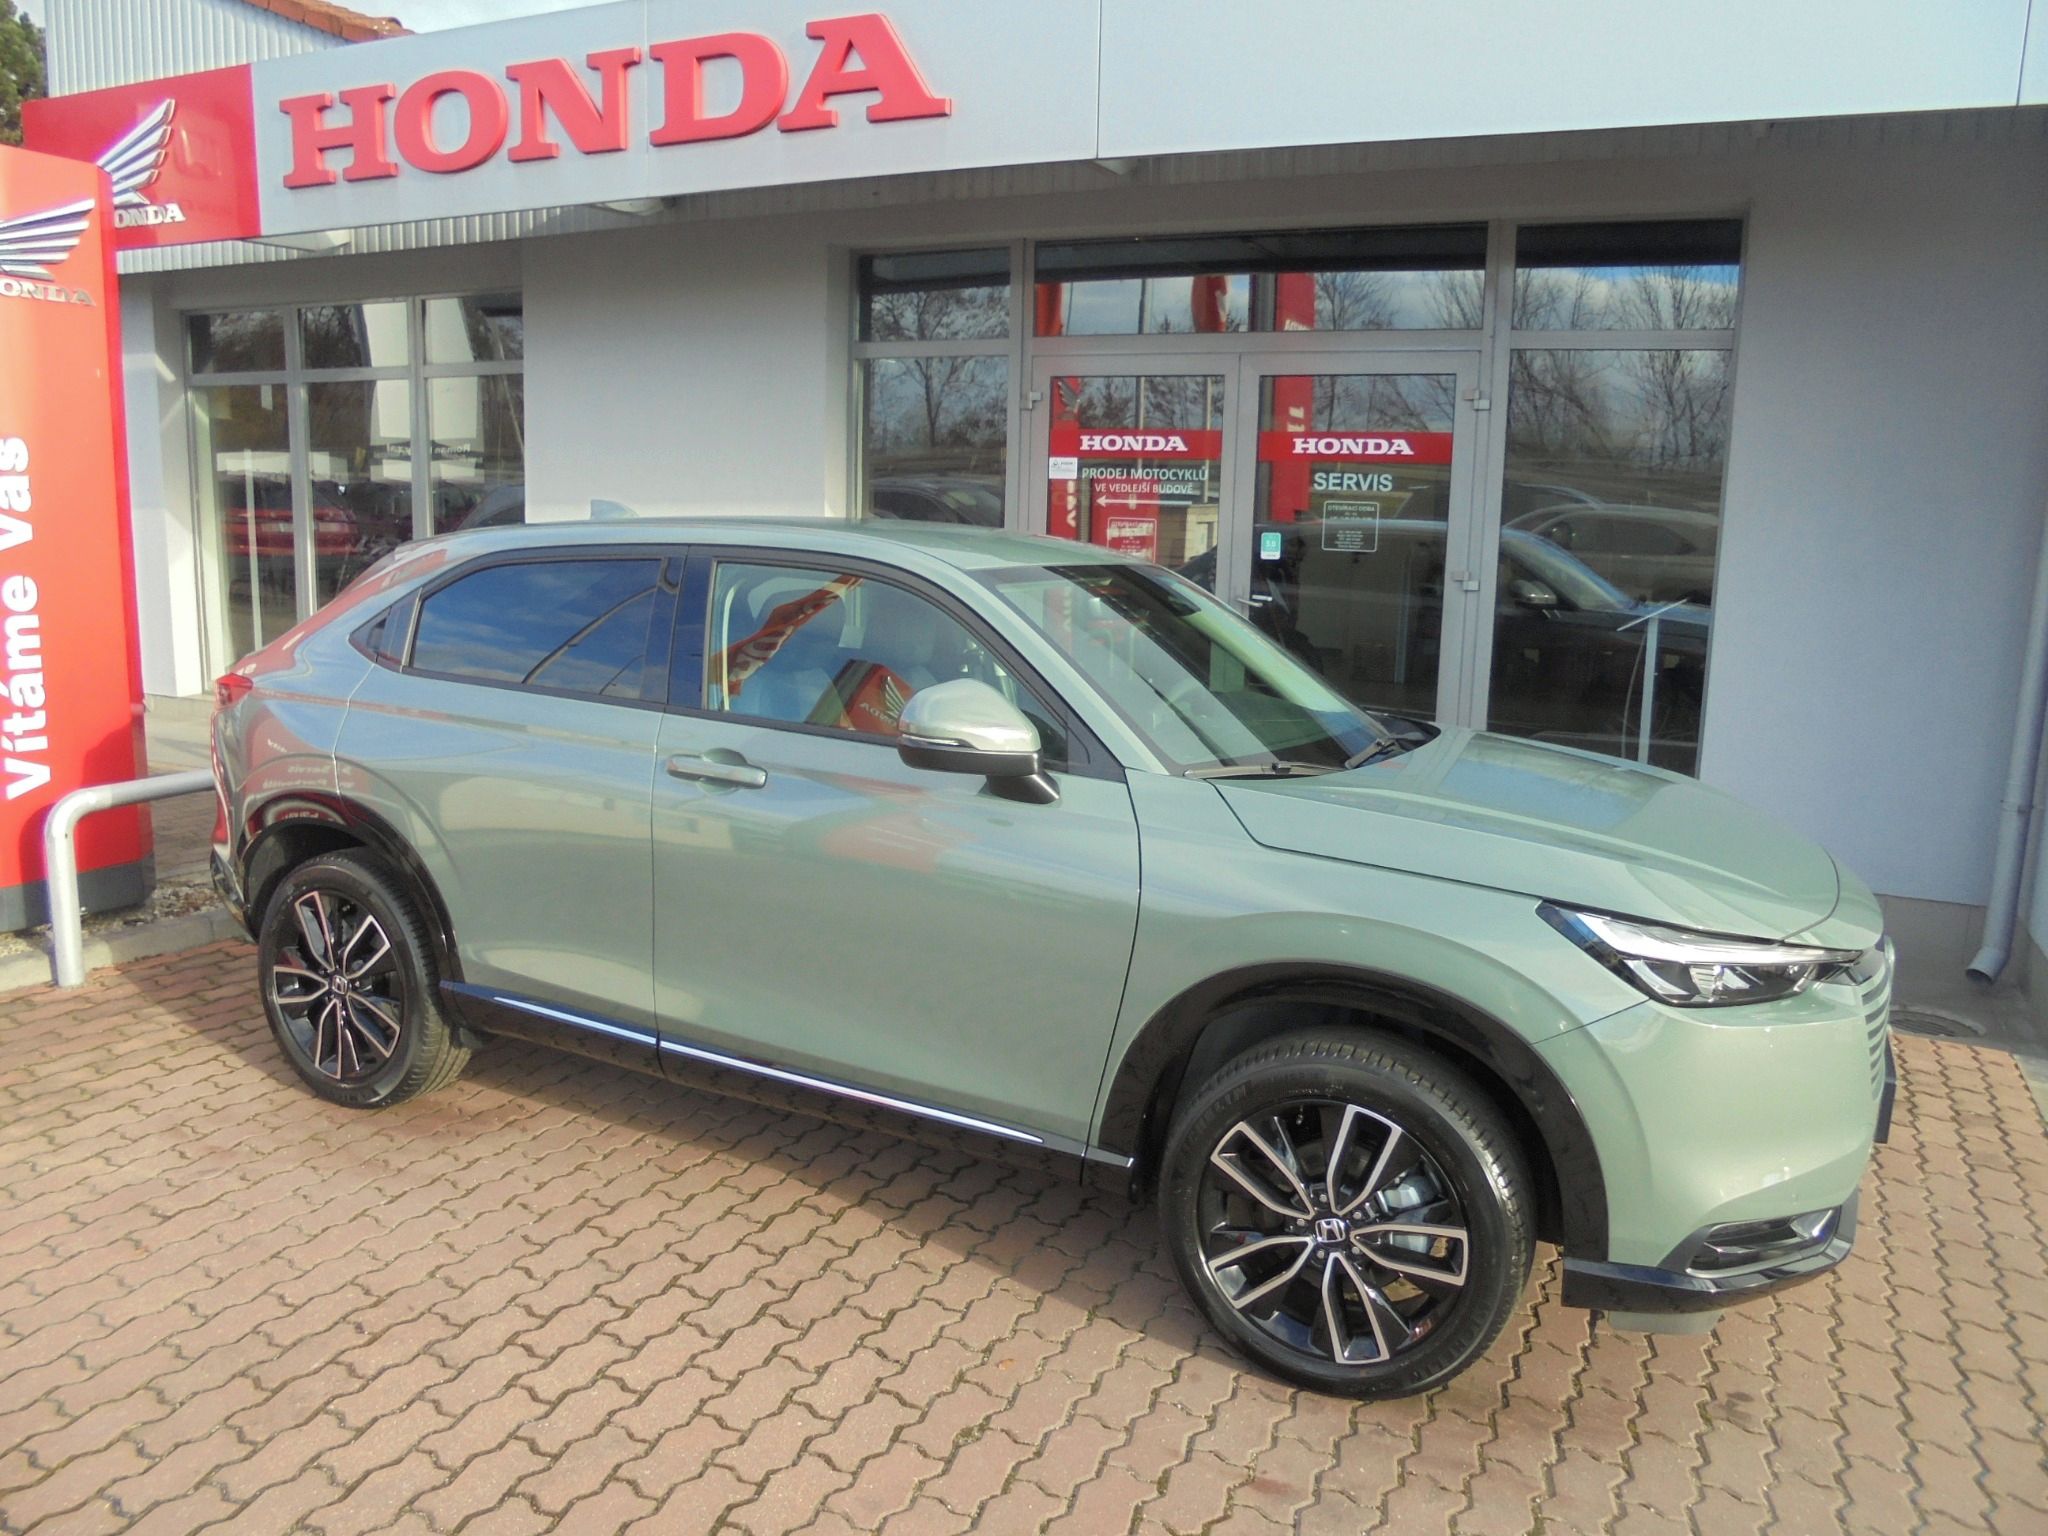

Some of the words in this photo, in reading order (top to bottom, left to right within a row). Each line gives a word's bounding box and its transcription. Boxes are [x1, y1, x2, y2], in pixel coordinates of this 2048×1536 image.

[280, 13, 952, 189] HONDA
[114, 203, 186, 229] ONDA
[0, 278, 96, 307] ONDA
[1080, 435, 1188, 452] HONDA
[1292, 437, 1415, 455] HONDA
[1082, 467, 1127, 480] PRODEJ
[1130, 465, 1208, 481] MOTOCYKLŮ
[1313, 472, 1393, 492] SERVIS
[1095, 483, 1107, 493] VE
[1109, 481, 1150, 494] VEDLEJŠÍ
[1152, 482, 1193, 495] BUDOVĚ
[0, 574, 52, 800] Vítáme
